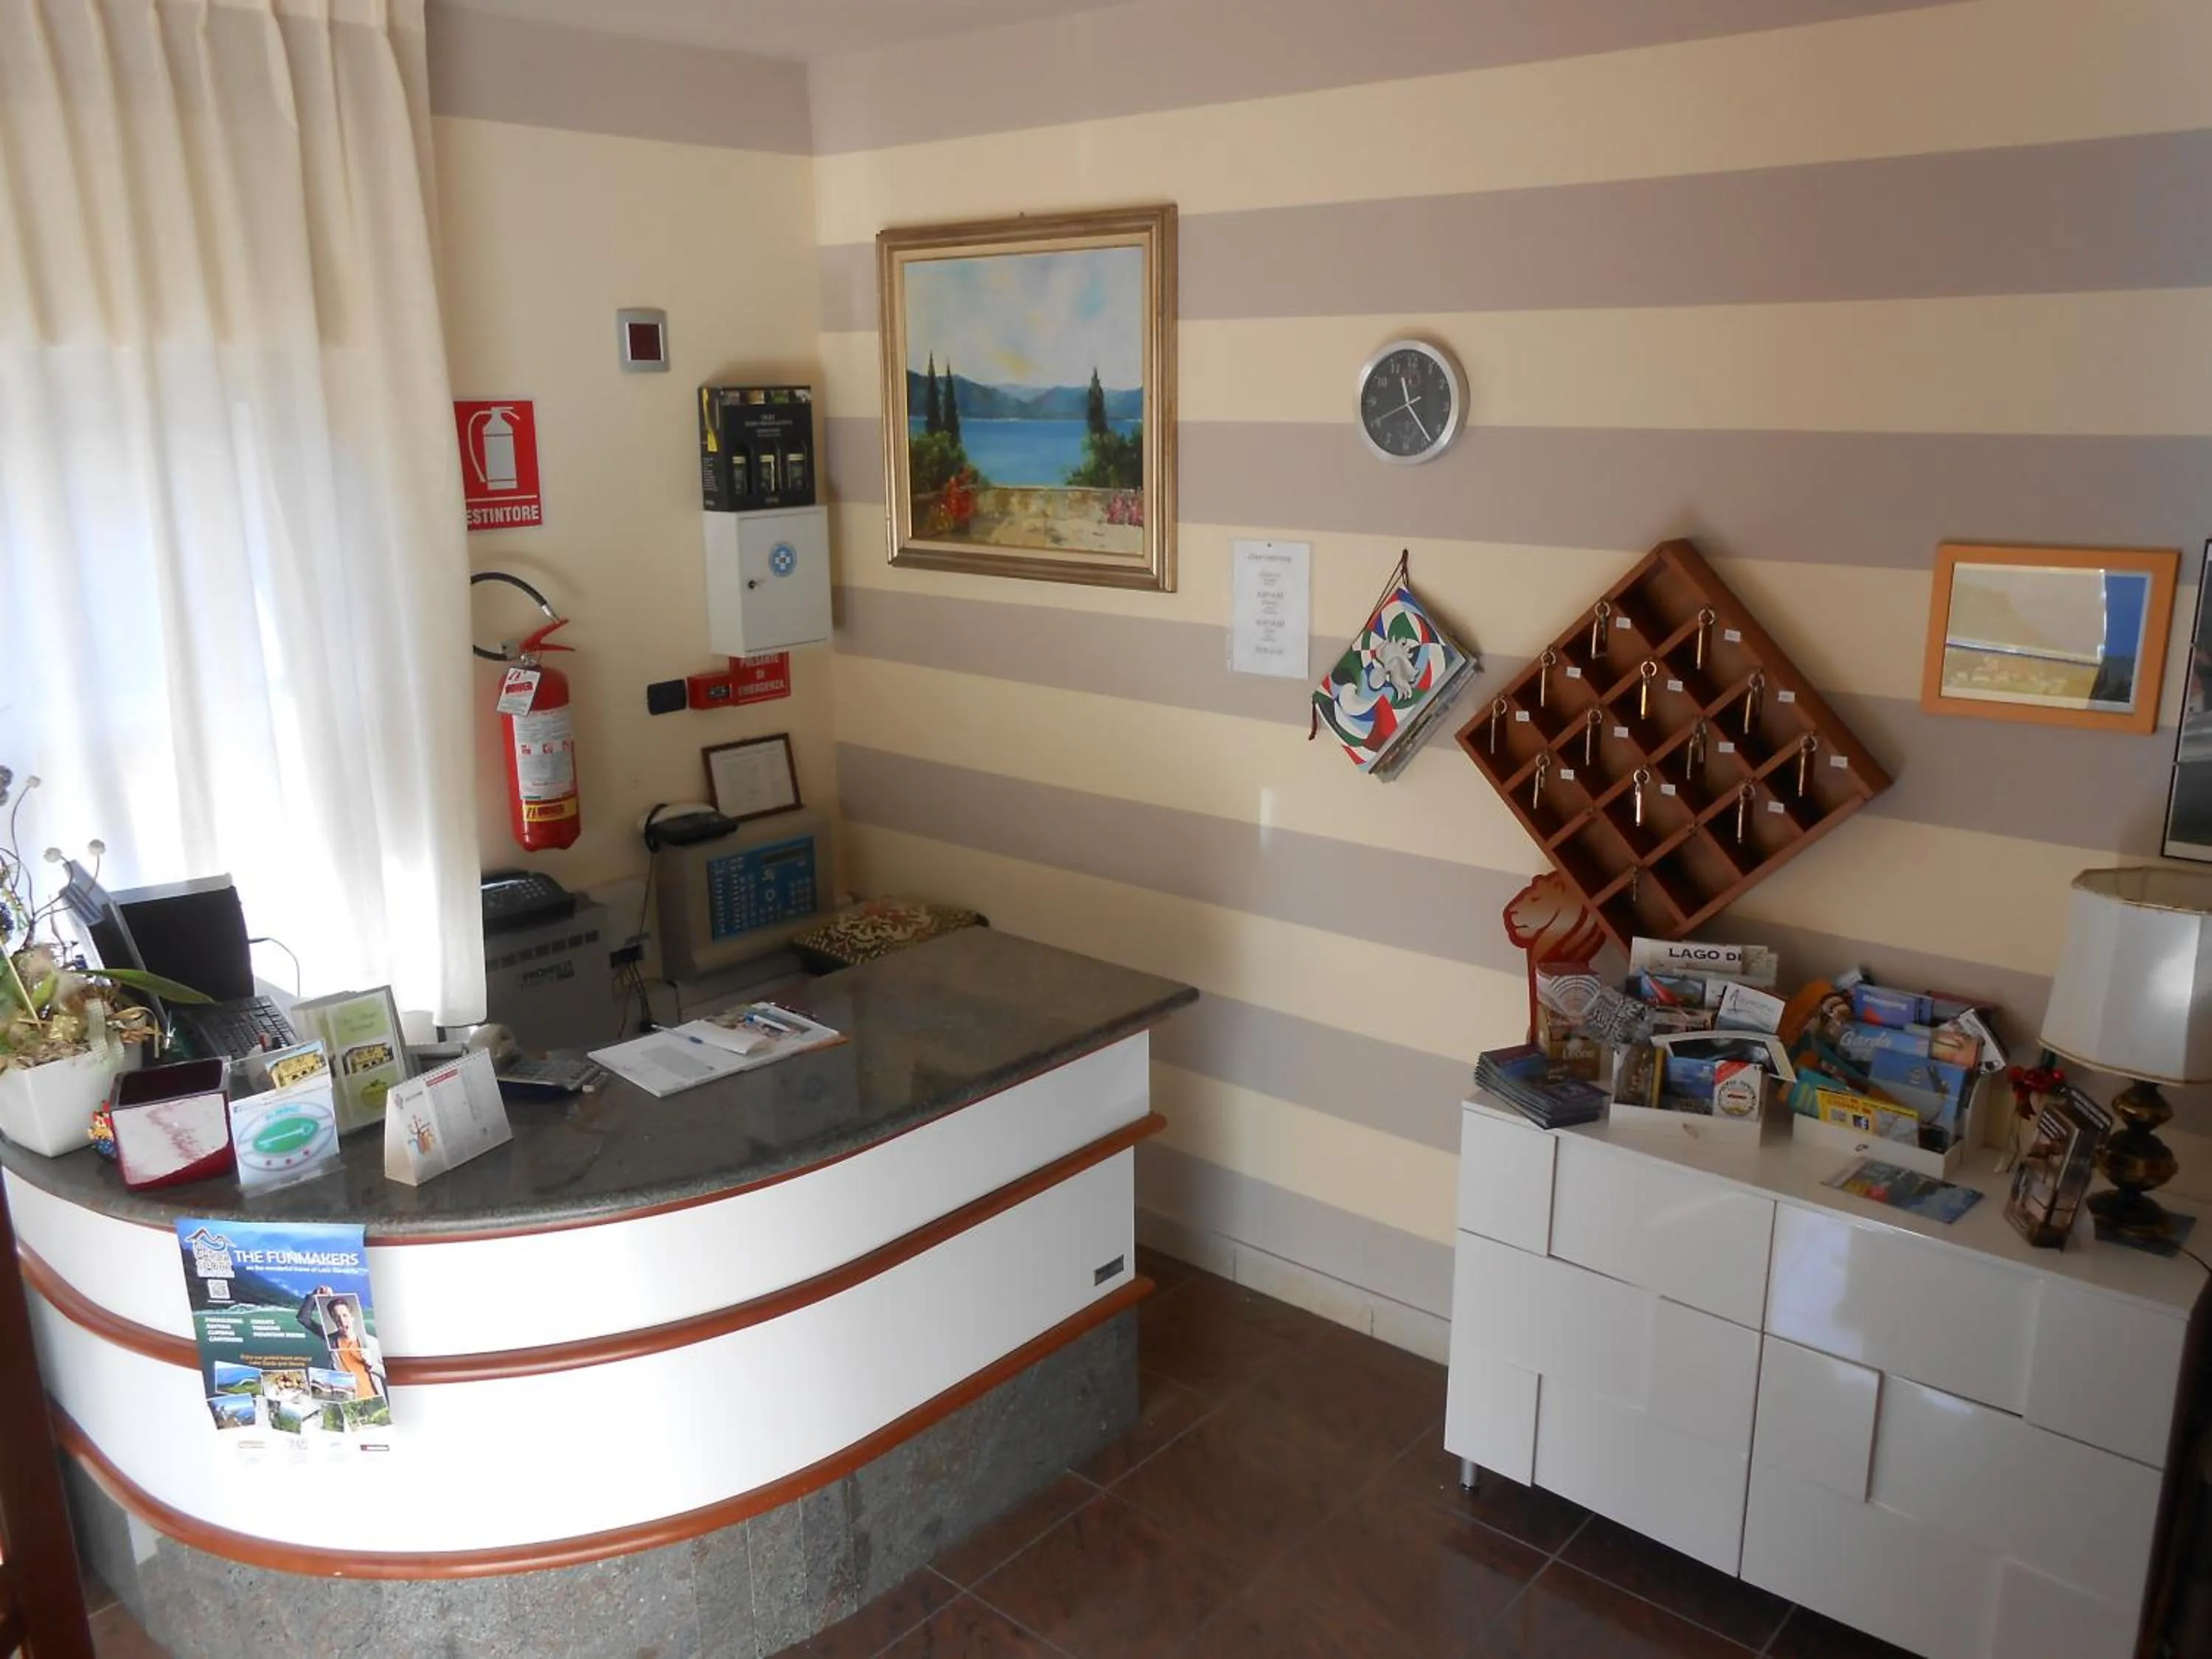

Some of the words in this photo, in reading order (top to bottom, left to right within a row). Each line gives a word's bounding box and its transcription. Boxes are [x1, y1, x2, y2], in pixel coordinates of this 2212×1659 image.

[467, 506, 539, 524] ESTINTORE
[1669, 947, 1720, 959] LAGO
[234, 1250, 265, 1263] THE
[267, 1251, 359, 1266] FUNMAKERS
